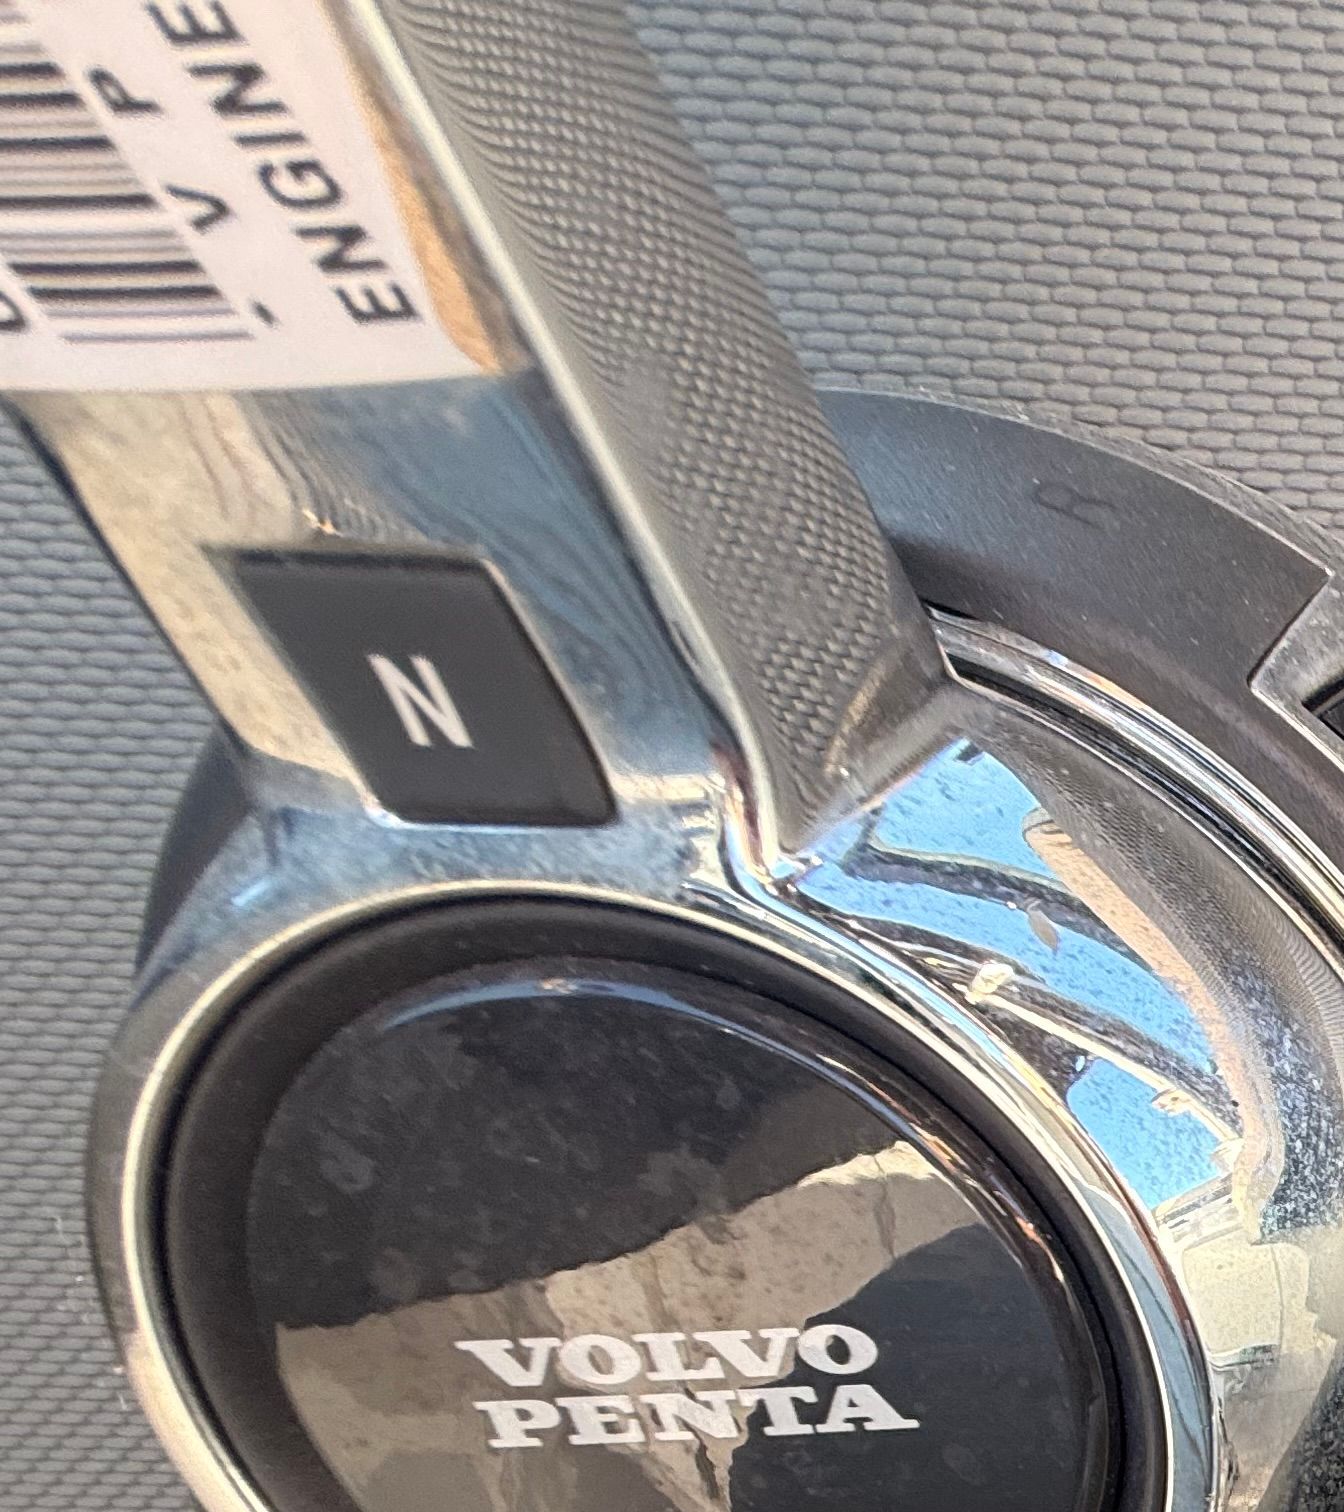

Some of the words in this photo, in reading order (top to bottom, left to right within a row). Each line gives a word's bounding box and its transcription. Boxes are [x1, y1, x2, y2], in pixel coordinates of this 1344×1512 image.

[144, 0, 418, 324] ENGINE
[368, 653, 474, 749] N
[454, 1323, 879, 1388] VOLVO
[472, 1383, 921, 1449] PENTA
